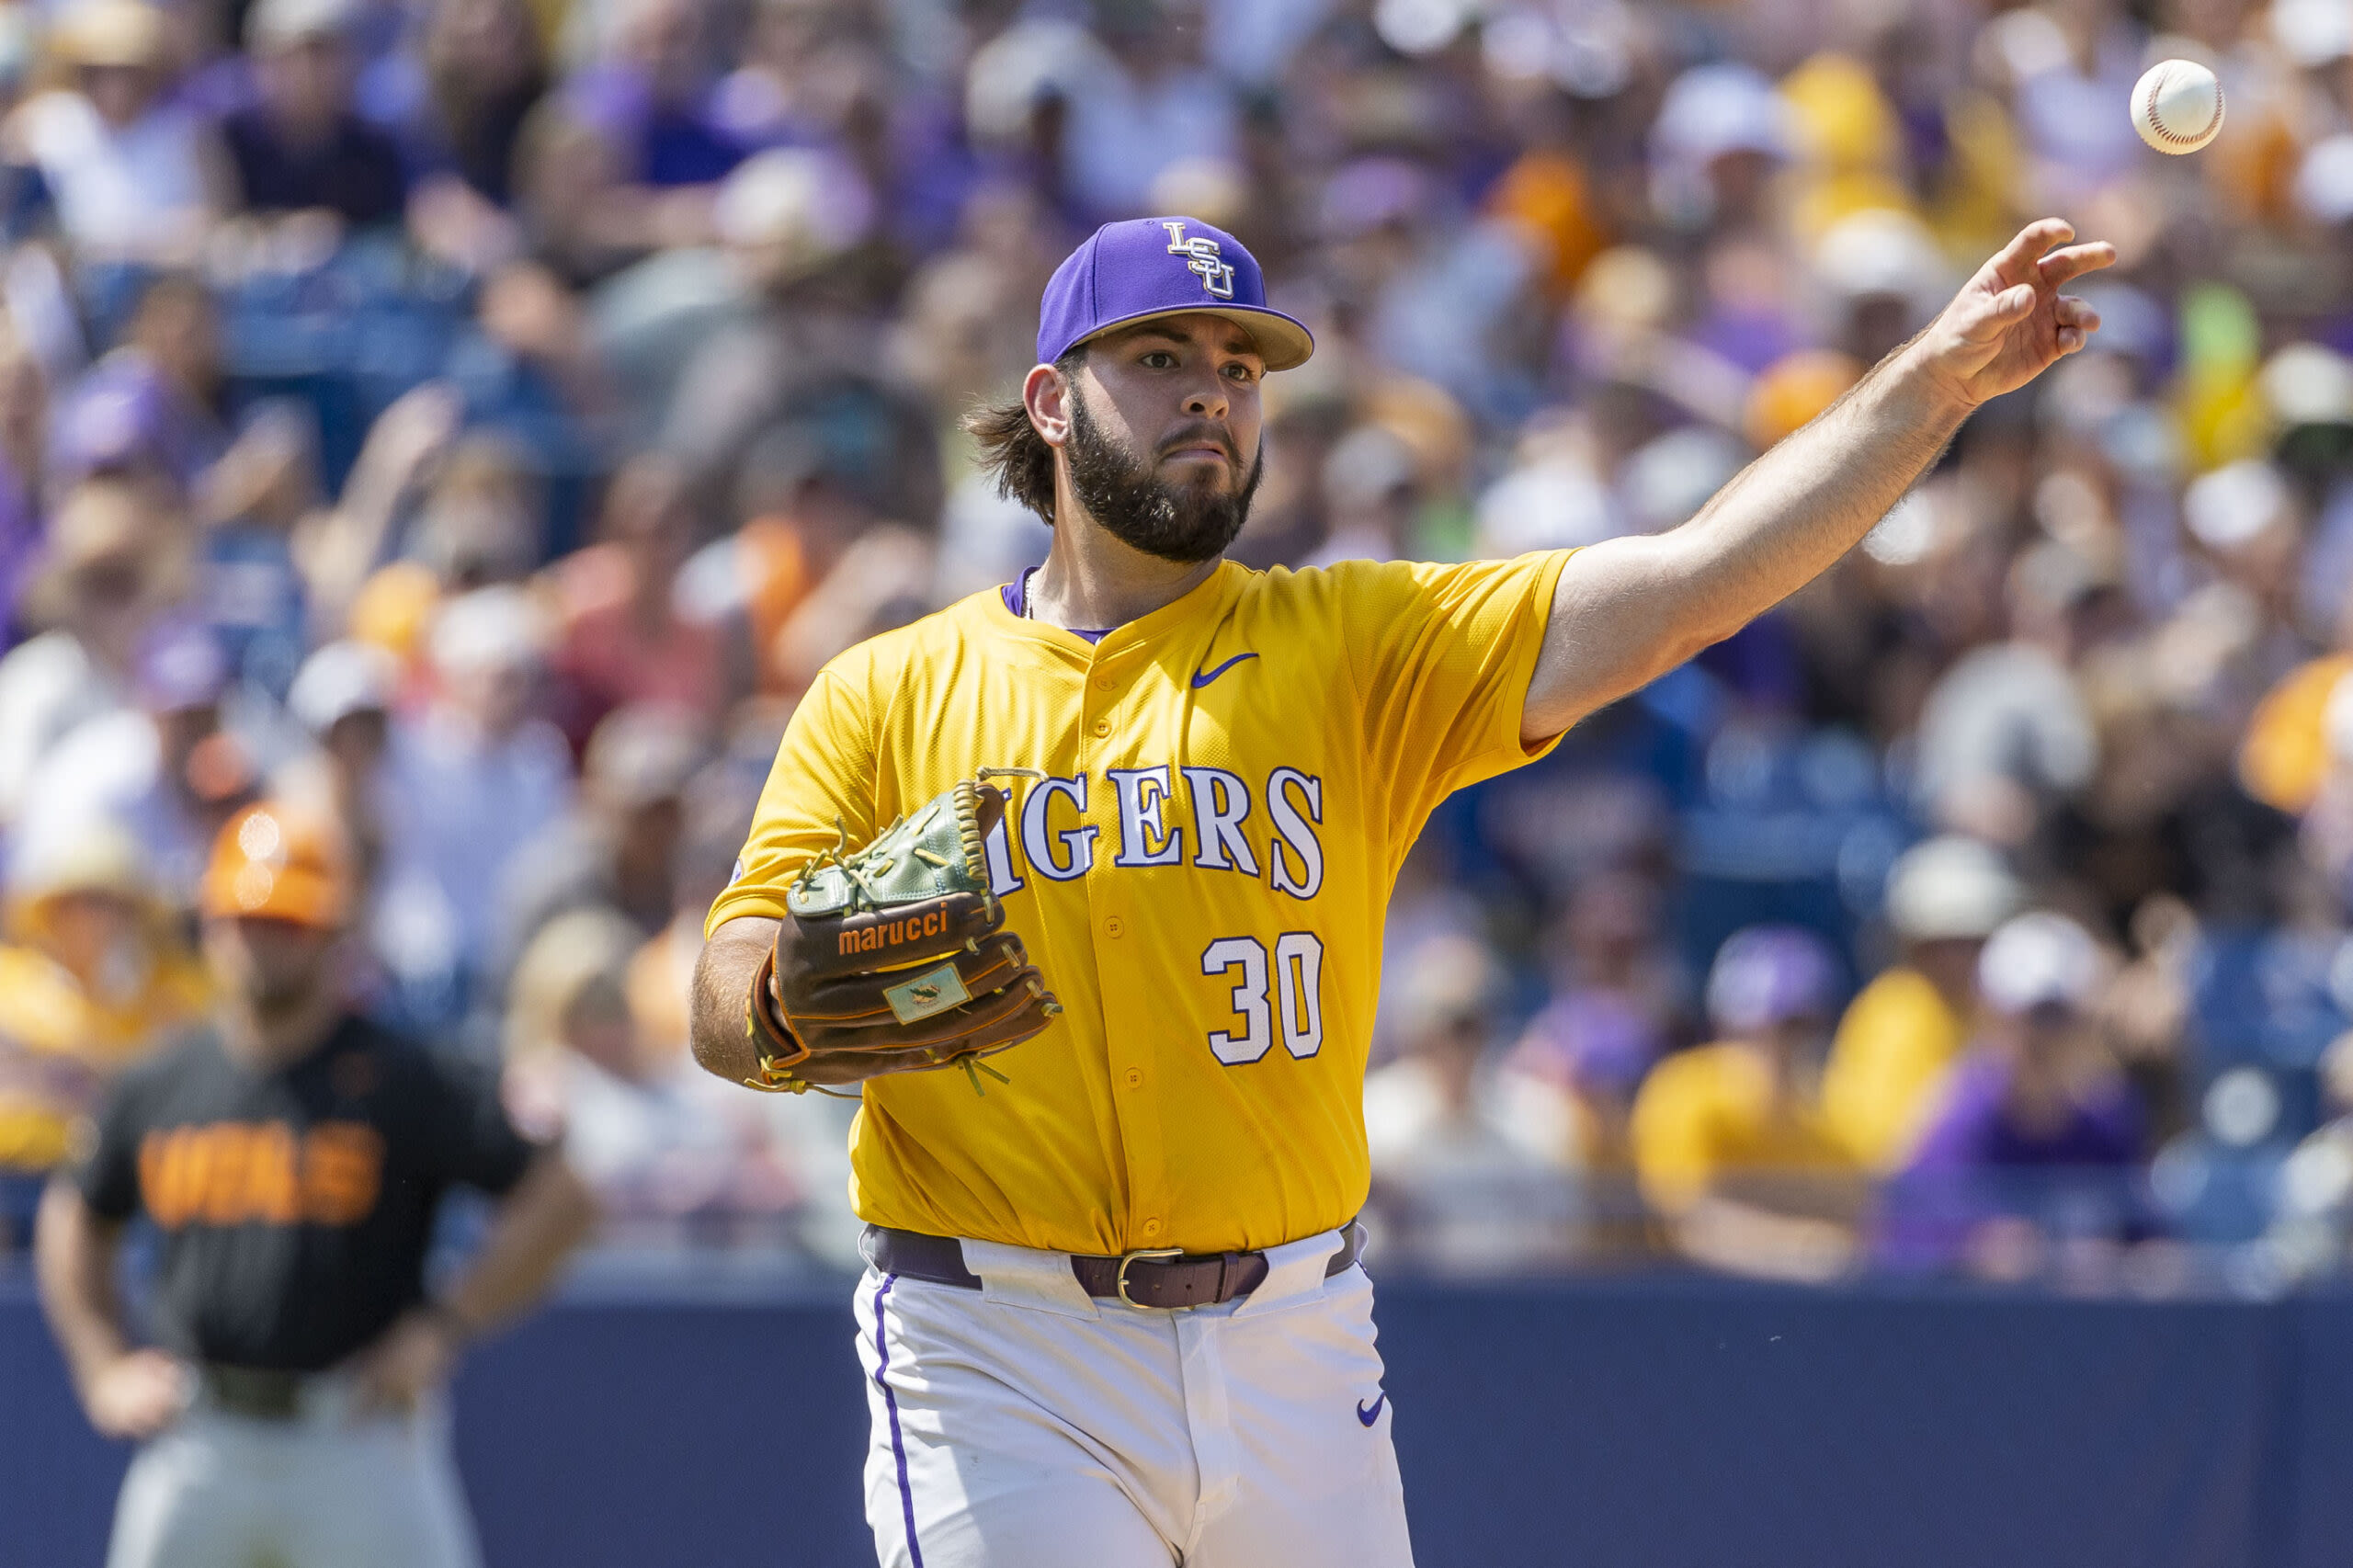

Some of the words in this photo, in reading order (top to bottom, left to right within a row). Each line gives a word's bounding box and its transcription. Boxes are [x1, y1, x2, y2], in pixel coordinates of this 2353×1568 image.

[1163, 222, 1234, 300] LSU
[983, 764, 1324, 901] IGERS
[838, 902, 949, 956] marucci
[1200, 931, 1324, 1066] 30
